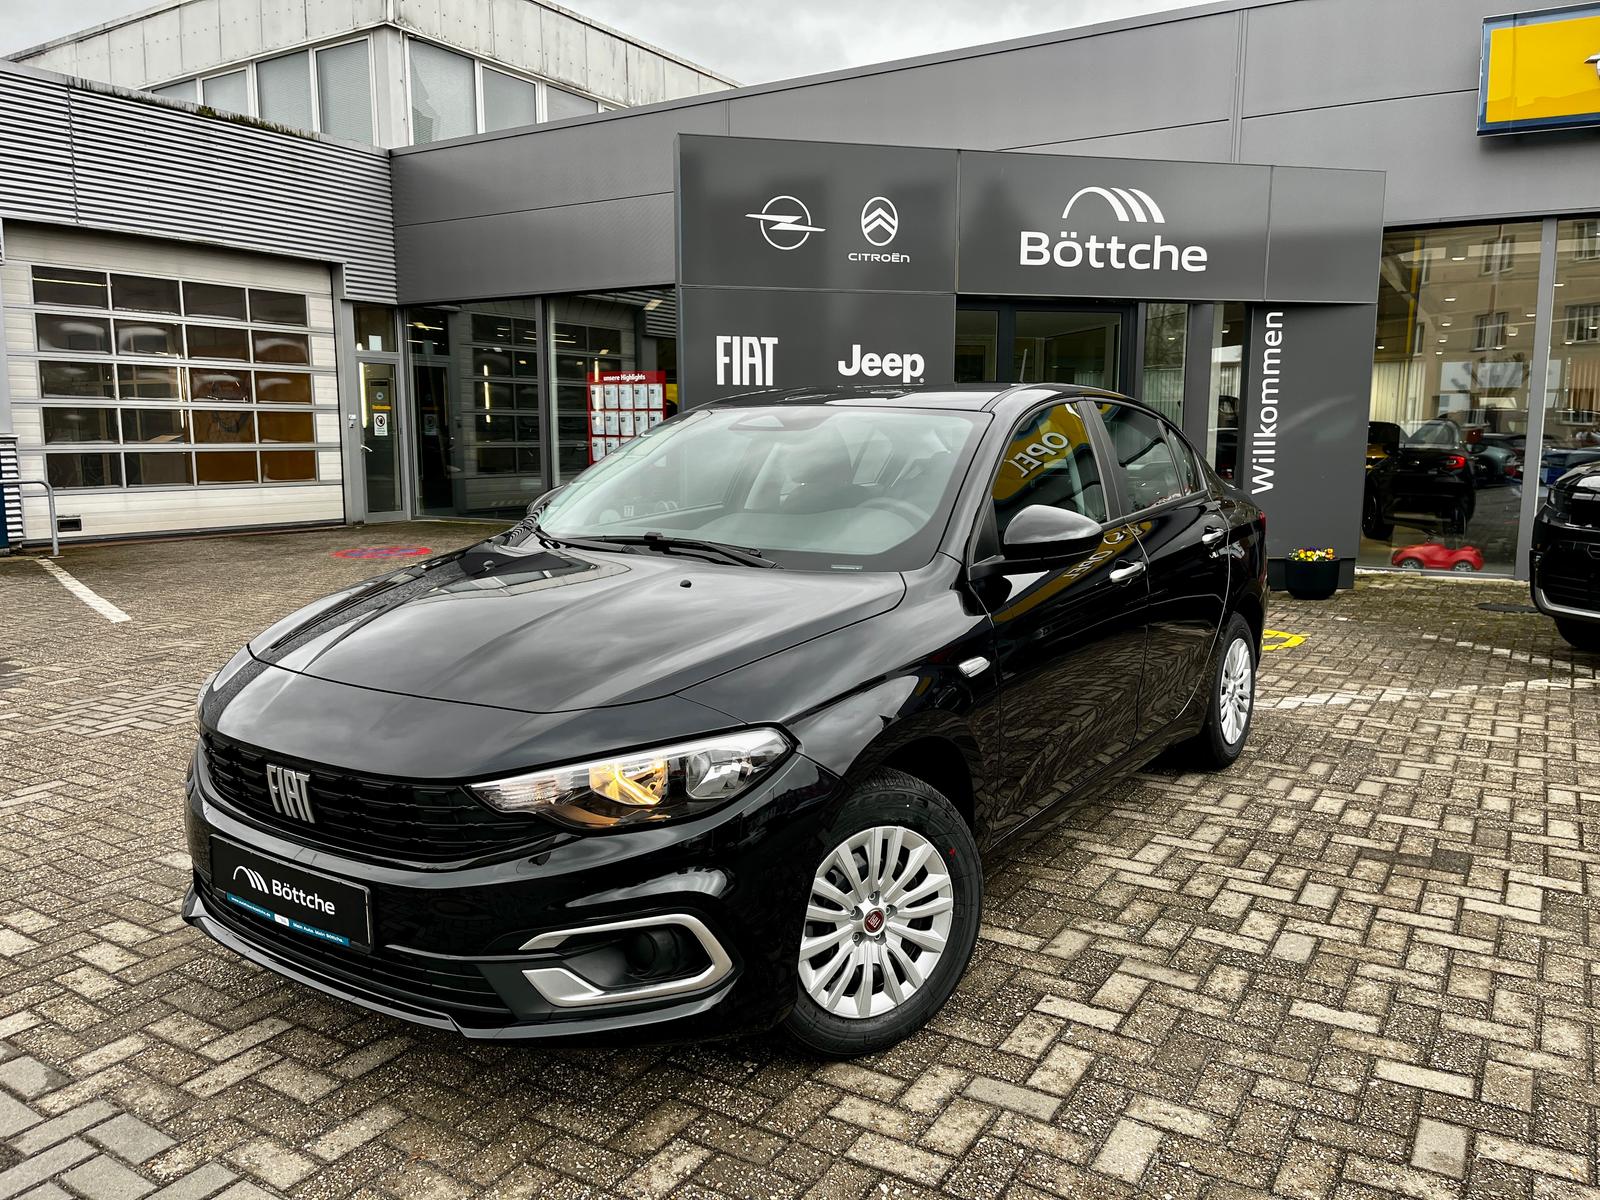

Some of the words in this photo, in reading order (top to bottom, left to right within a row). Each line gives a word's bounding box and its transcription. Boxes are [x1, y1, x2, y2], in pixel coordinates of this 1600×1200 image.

[847, 252, 911, 263] CITROËN
[1019, 231, 1208, 272] Böttche
[620, 373, 646, 382] Highlights
[716, 335, 779, 386] FIAT
[837, 344, 925, 384] Jeep
[1251, 311, 1284, 495] Willkommen
[266, 763, 316, 824] FIAT
[271, 878, 336, 916] Böttche
